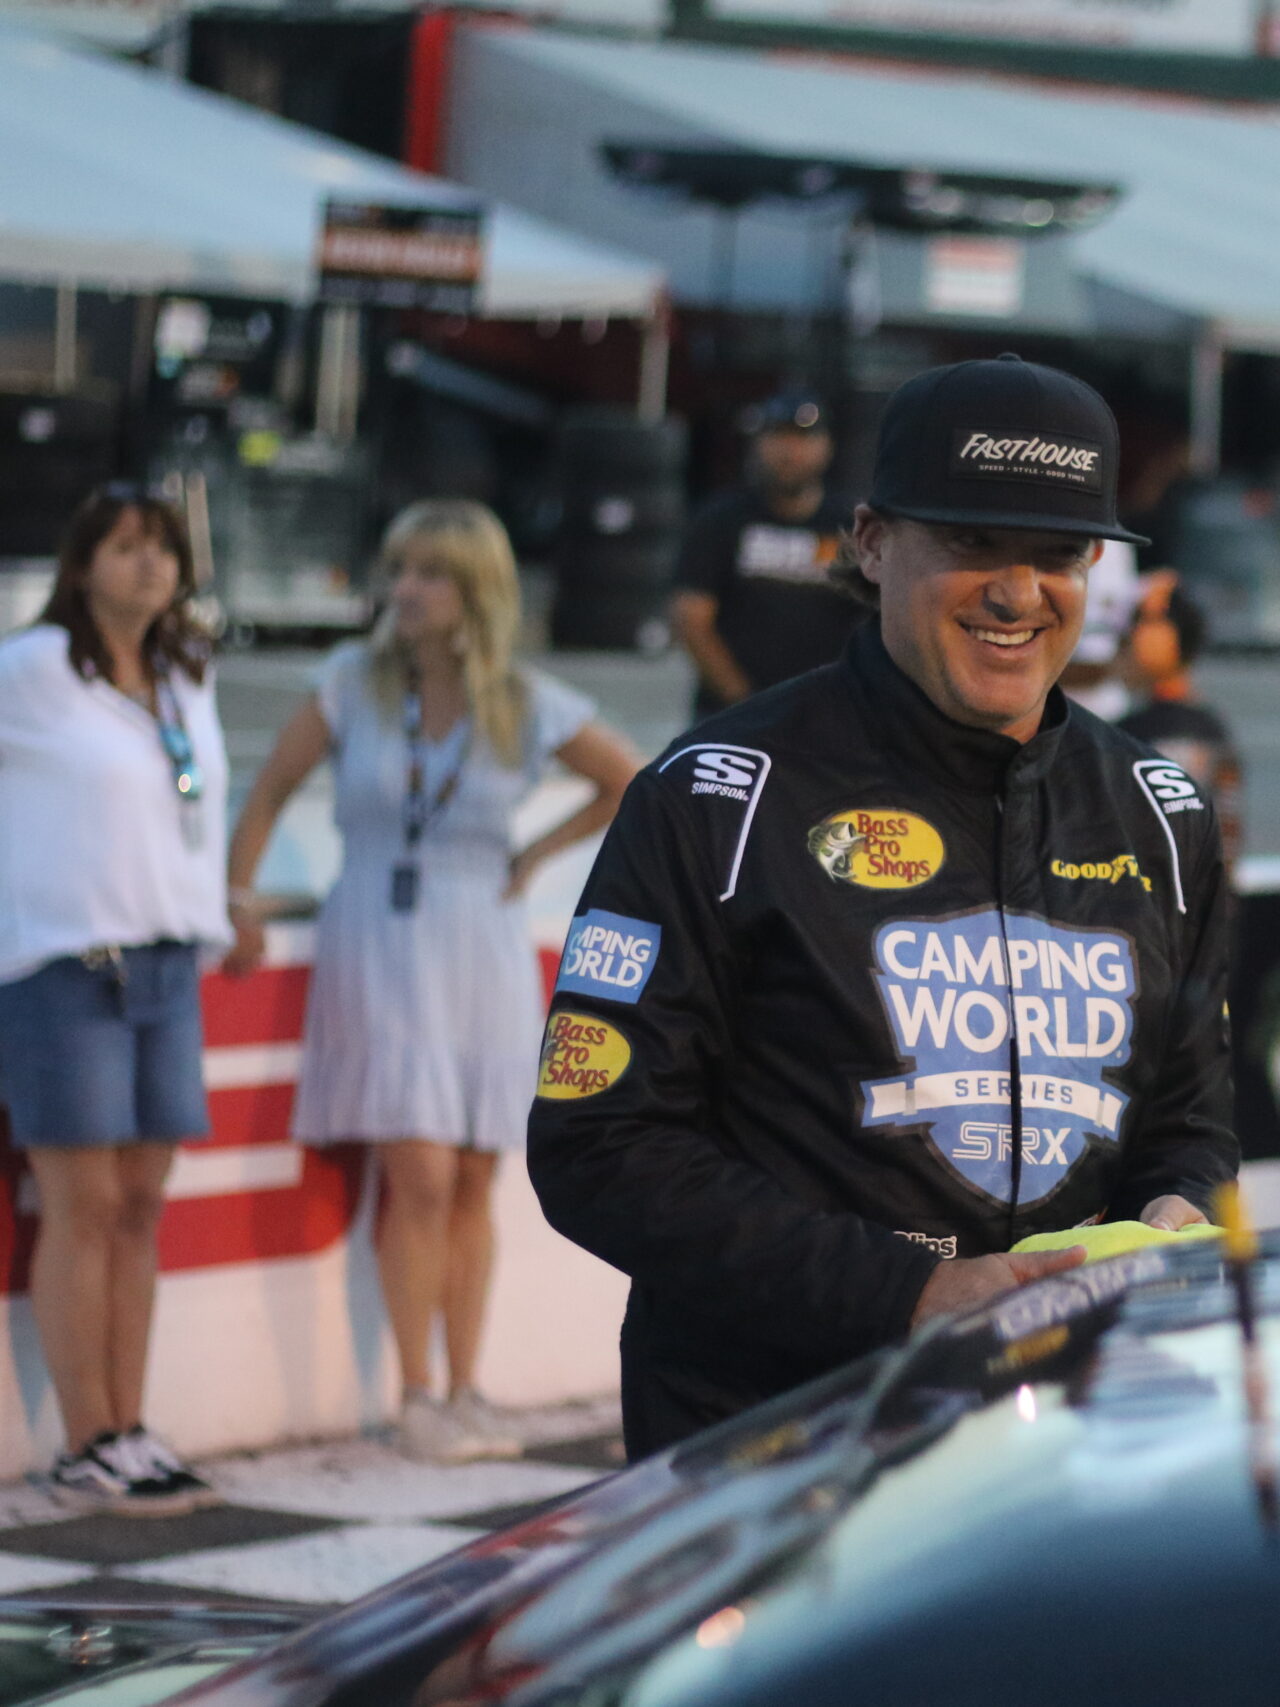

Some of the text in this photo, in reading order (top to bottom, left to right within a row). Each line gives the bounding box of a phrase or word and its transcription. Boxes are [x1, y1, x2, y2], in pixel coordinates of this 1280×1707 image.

[960, 433, 1099, 471] FASTHOUSE
[1013, 467, 1038, 475] STYLE
[691, 781, 748, 801] SIMPSON
[857, 813, 909, 836] Bass
[862, 834, 901, 856] Pro
[867, 854, 931, 882] Shops
[570, 925, 652, 963] MPING
[564, 949, 643, 988] ORLD
[883, 930, 1127, 992] CAMPING
[552, 1015, 608, 1046] Bass
[888, 984, 1127, 1058] WORLD
[547, 1038, 590, 1065] Pro
[543, 1060, 609, 1094] Shops
[954, 1077, 1073, 1105] SERIES
[952, 1121, 1072, 1165] SRX
